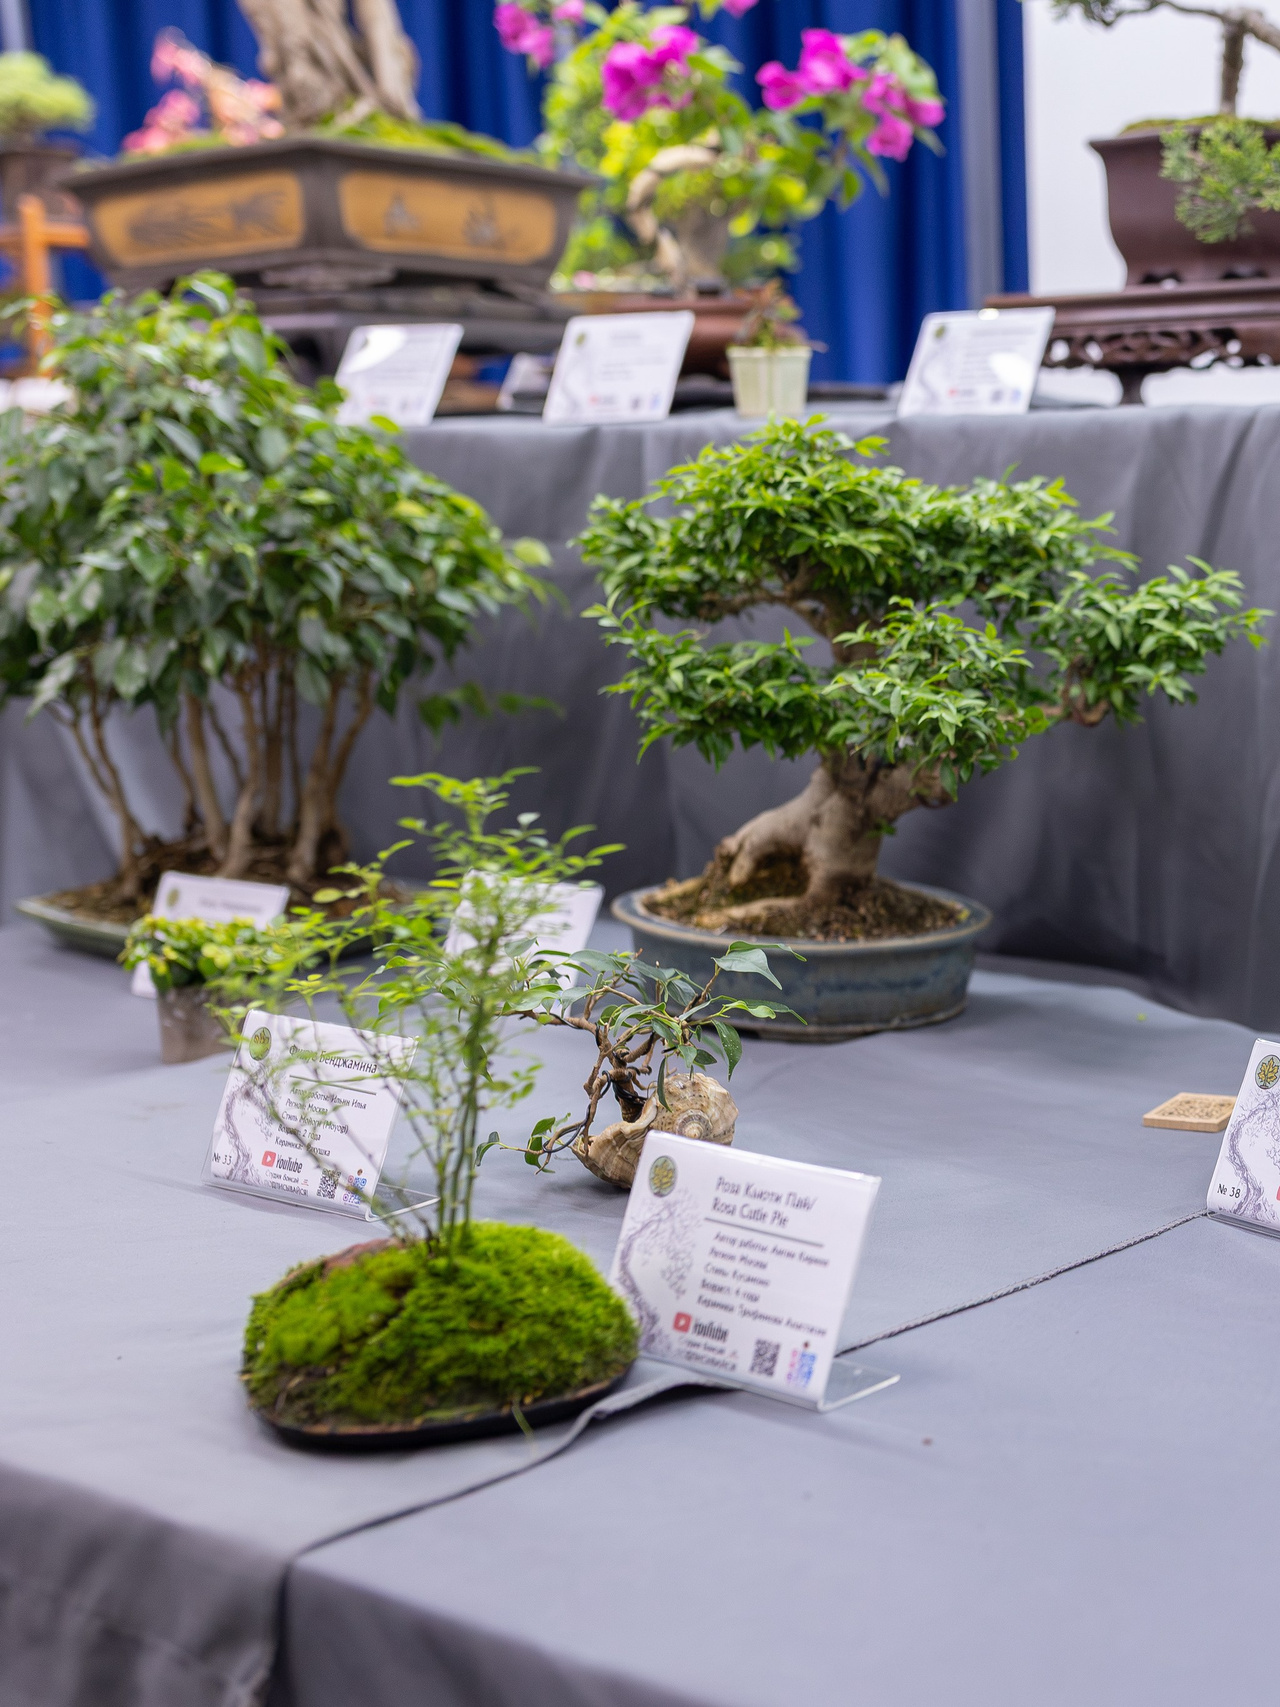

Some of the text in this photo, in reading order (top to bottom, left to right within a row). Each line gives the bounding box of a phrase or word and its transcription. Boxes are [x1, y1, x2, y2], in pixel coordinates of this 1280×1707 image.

[319, 1050, 378, 1074] Бенджамина
[351, 1098, 367, 1110] Илья
[302, 1128, 307, 1138] 2
[275, 1153, 303, 1173] YouTube
[1217, 1184, 1240, 1198] № 38
